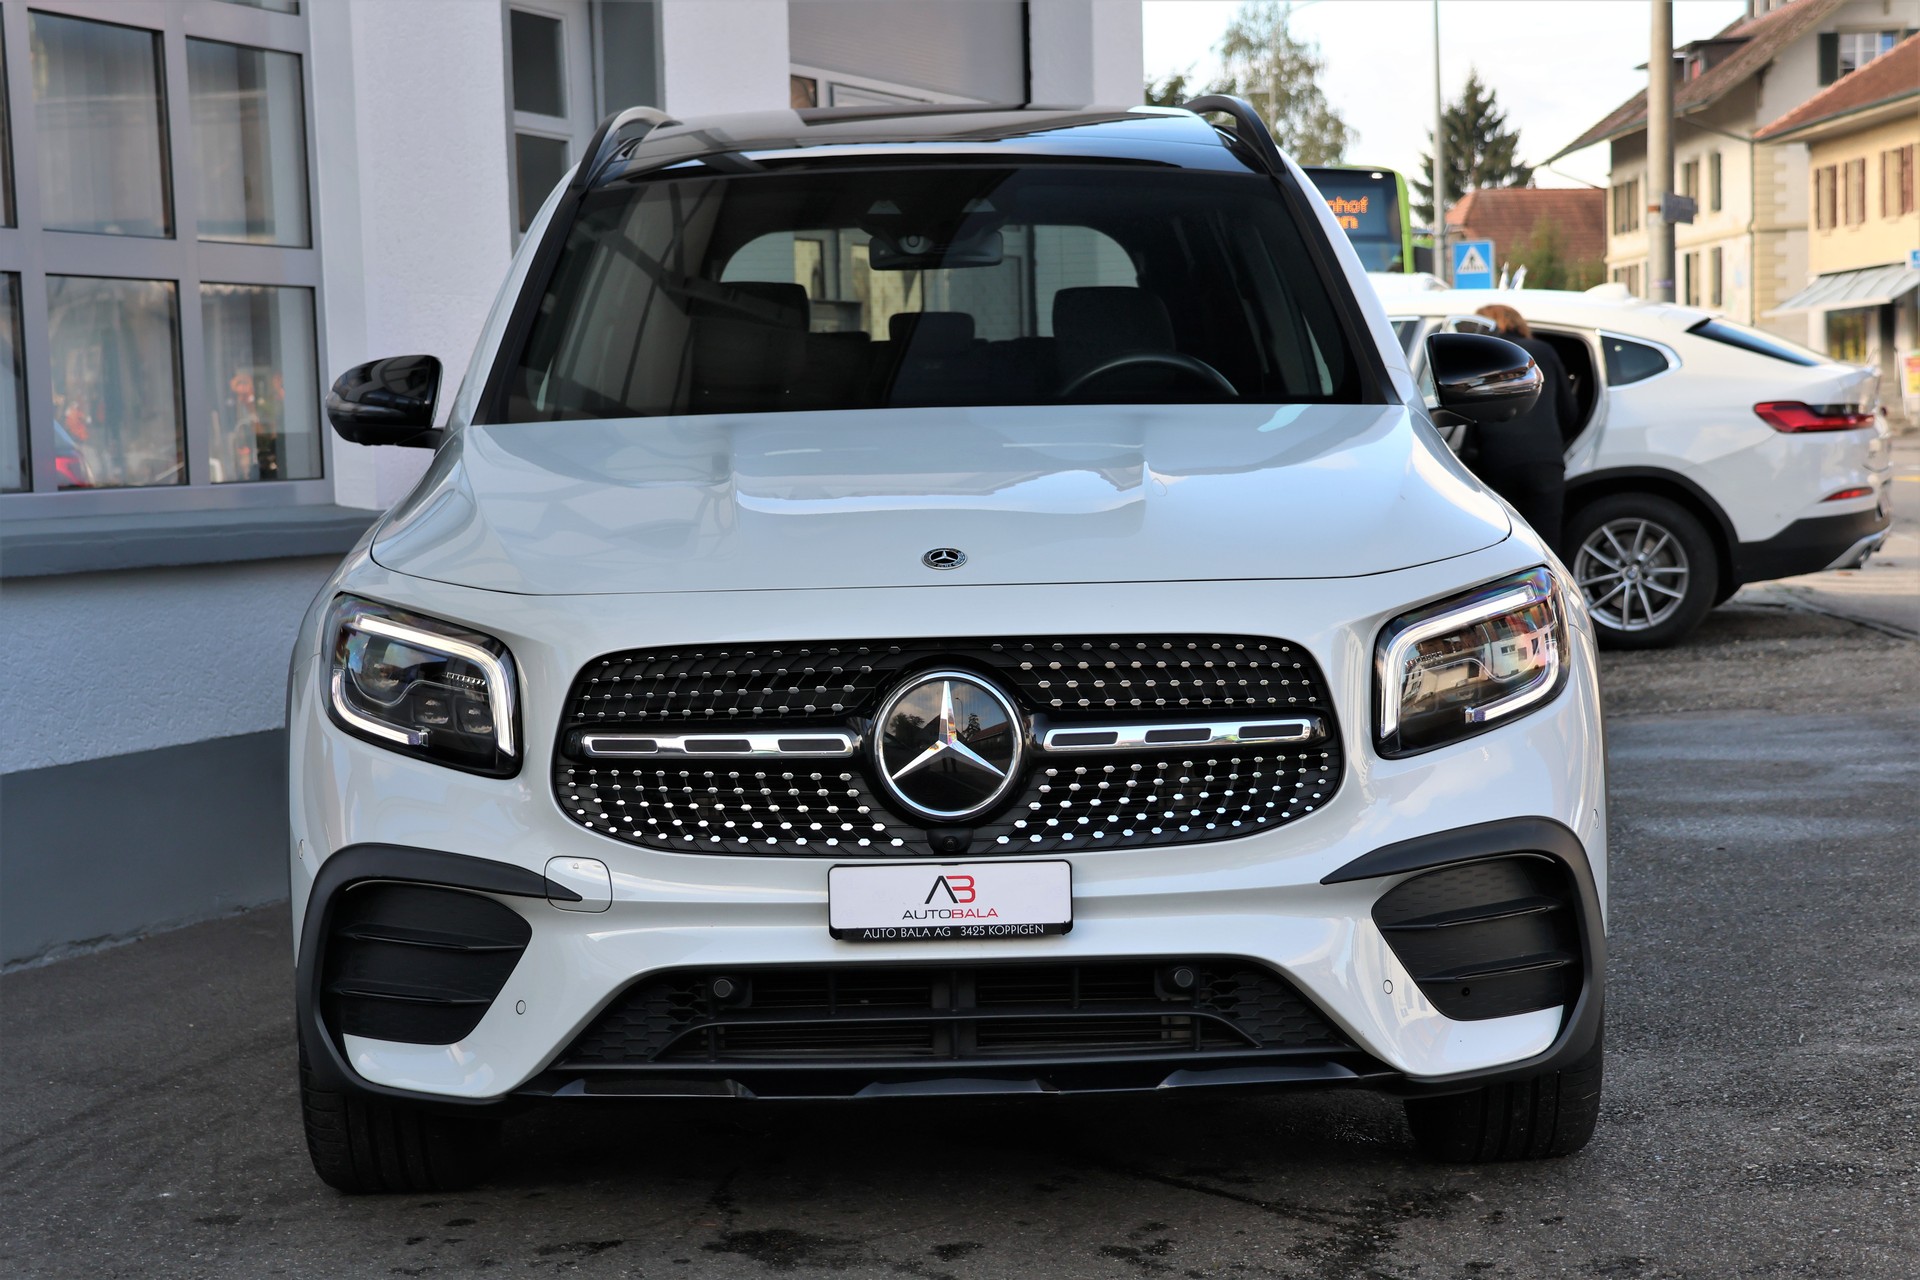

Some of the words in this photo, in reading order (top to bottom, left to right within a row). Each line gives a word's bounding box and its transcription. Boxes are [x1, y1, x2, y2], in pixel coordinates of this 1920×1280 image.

[902, 908, 998, 920] AUTOBALA
[863, 928, 897, 939] AUTO
[900, 927, 930, 937] BALA
[934, 926, 951, 937] AG
[960, 924, 985, 936] 3425
[988, 924, 1044, 935] KOPPIGEN
